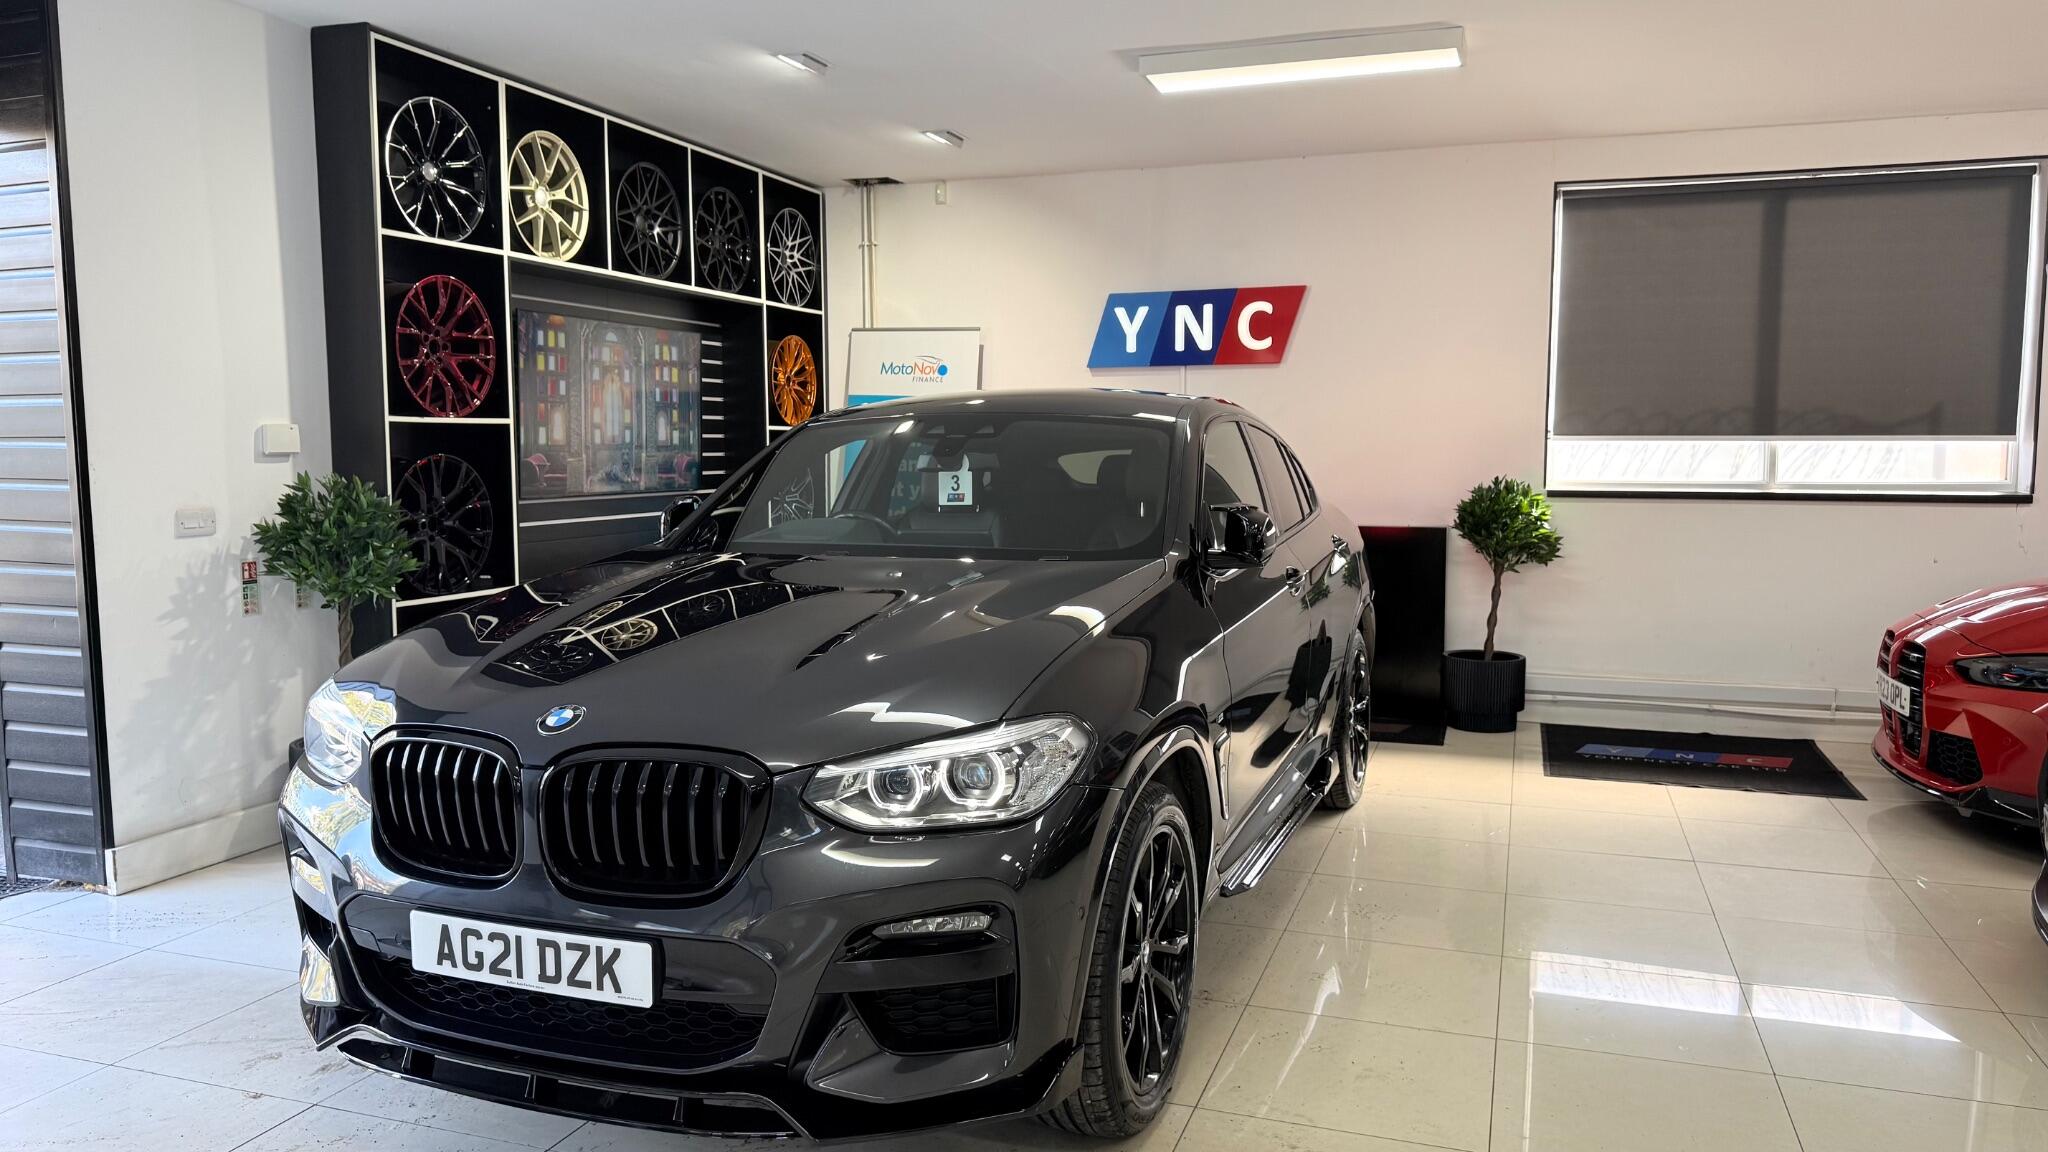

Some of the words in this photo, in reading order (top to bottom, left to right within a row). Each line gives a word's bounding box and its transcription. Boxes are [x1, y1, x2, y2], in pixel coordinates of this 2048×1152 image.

[951, 475, 960, 492] 3
[1890, 682, 1905, 710] OPL
[436, 923, 524, 980] AG21
[535, 937, 622, 994] DZK
